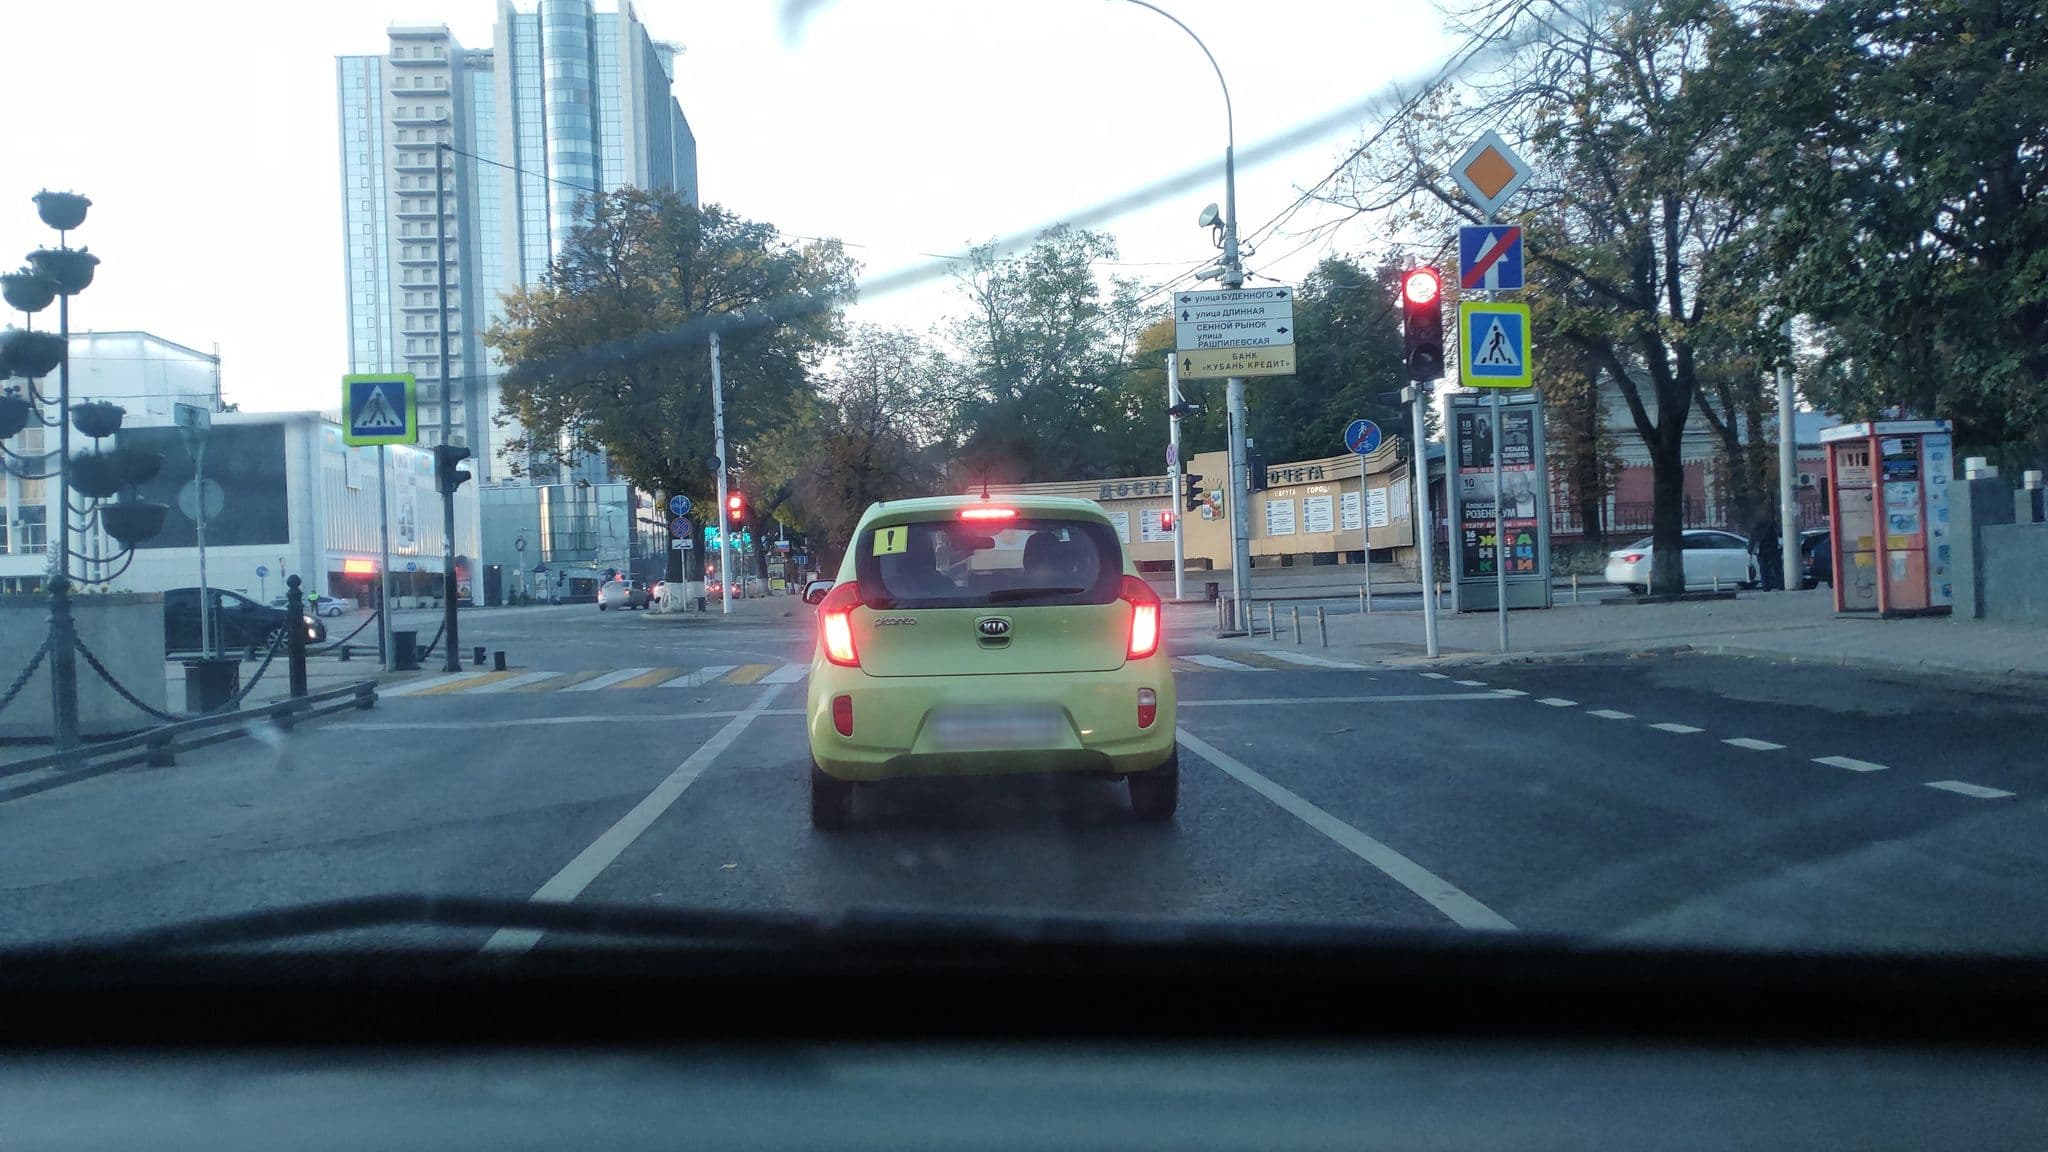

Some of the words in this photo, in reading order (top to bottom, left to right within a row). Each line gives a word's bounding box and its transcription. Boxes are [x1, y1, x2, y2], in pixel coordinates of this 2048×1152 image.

[1195, 295, 1220, 303] улица
[1221, 290, 1273, 301] БУДЕННОГО
[1195, 310, 1221, 319] улица
[1222, 307, 1265, 317] ДЛИННАЯ
[1197, 322, 1233, 331] СЕННОЙ
[1235, 321, 1267, 330] РЫНОК
[1198, 337, 1270, 349] РАШПИЛЕВСКАЯ
[1232, 352, 1257, 360] БАНК
[1269, 465, 1324, 484] ОЧЕТА
[1465, 508, 1516, 519] РОЗЕНБУМ
